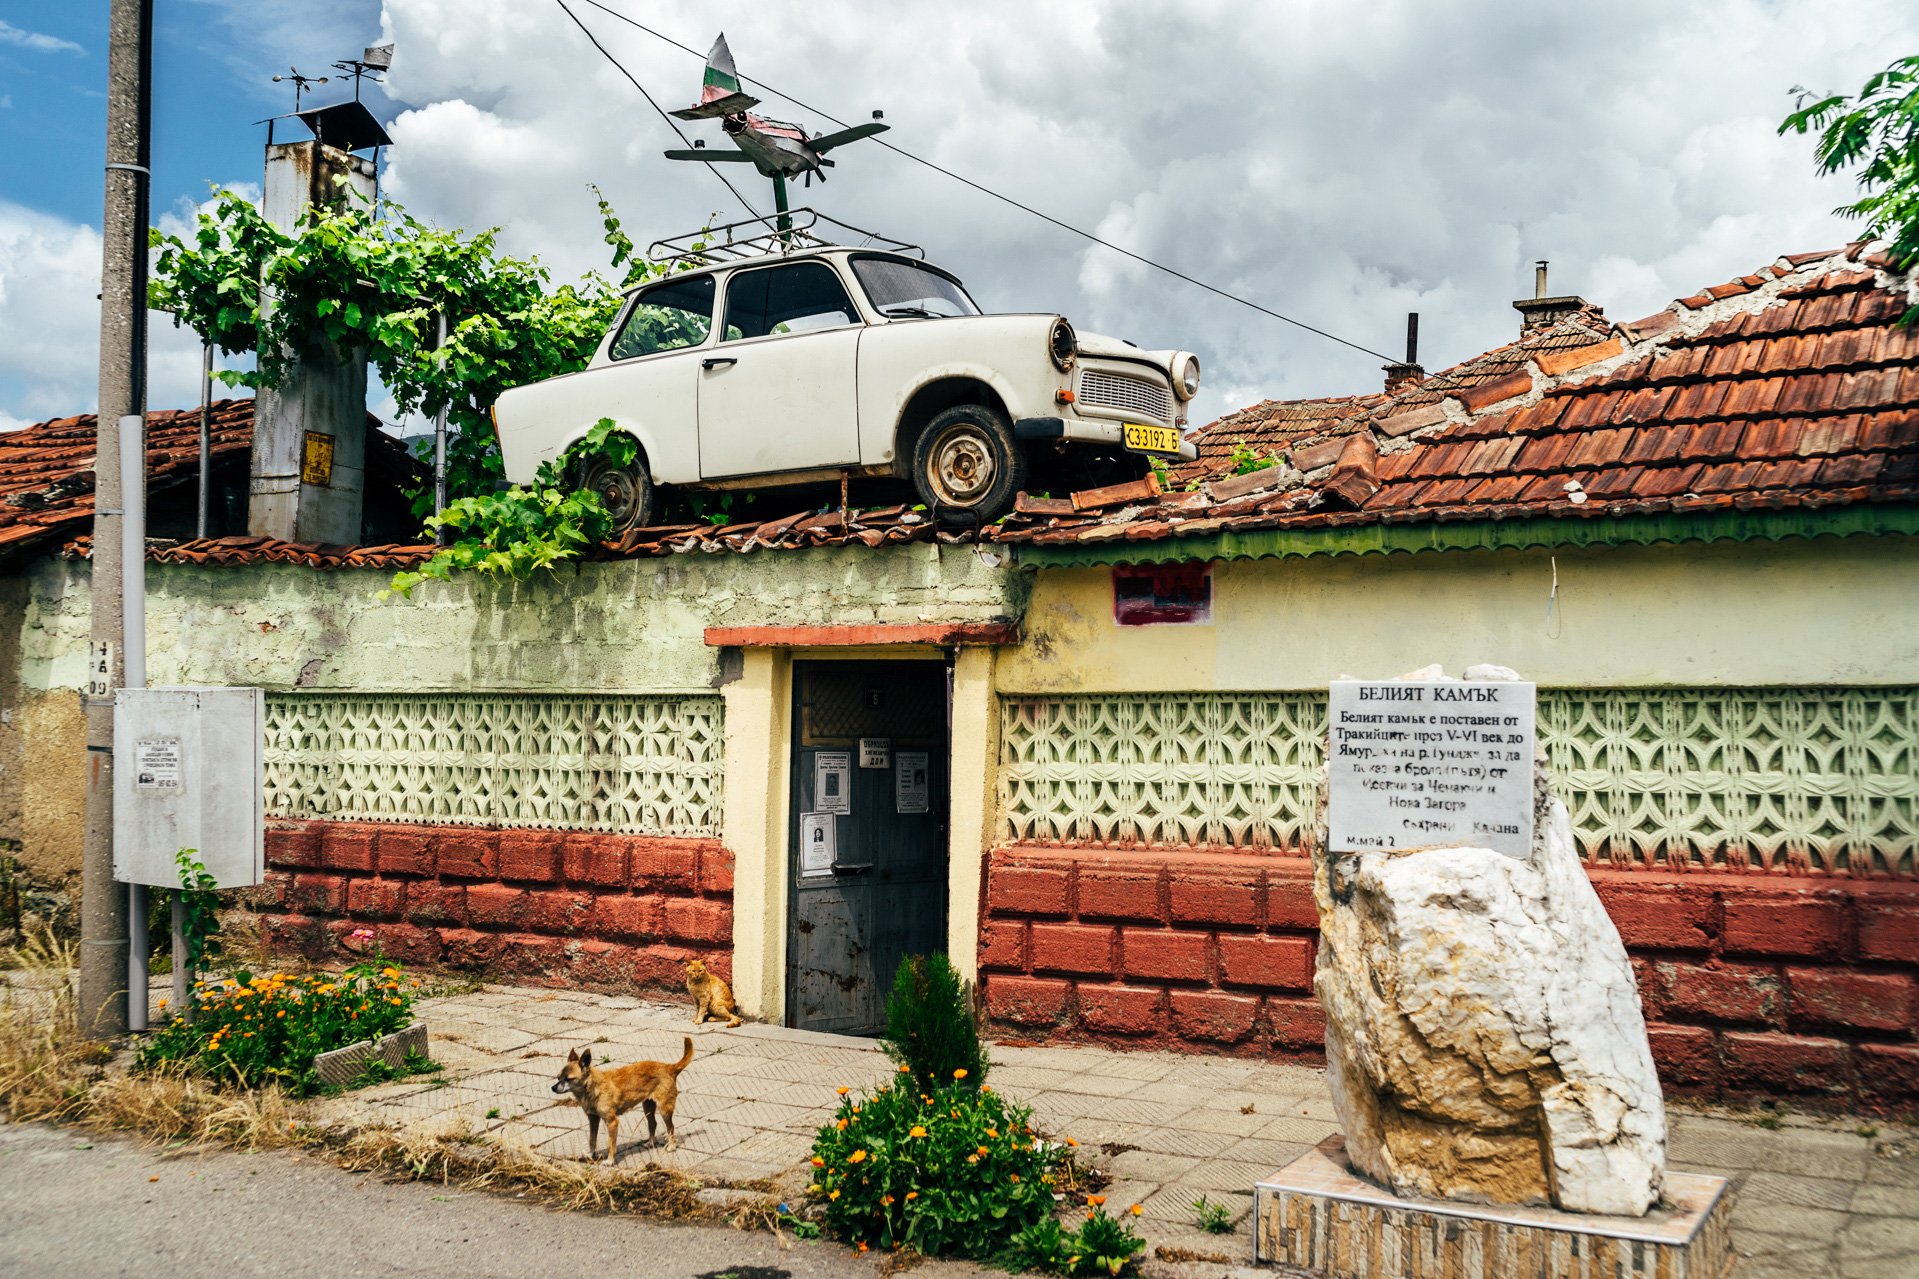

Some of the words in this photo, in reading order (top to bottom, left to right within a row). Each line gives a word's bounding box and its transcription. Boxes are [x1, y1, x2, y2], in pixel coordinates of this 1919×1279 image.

[872, 693, 879, 706] 5
[1359, 687, 1424, 701] БЕЛИЯТ
[1433, 687, 1498, 702] КАМЪК
[1340, 710, 1384, 723] Белият
[1429, 715, 1436, 724] е
[1440, 715, 1500, 726] поставен
[1503, 716, 1519, 726] от
[1336, 727, 1410, 742] Тракийците
[1446, 729, 1477, 742] V-VI
[1481, 732, 1503, 743] век
[1506, 733, 1524, 745] до
[1400, 749, 1415, 758] на
[1487, 750, 1501, 760] за
[869, 757, 884, 766] ДОМ
[1353, 764, 1401, 774] показа
[1489, 767, 1508, 778] от
[1411, 782, 1424, 791] за
[1389, 795, 1420, 808] Нова
[1424, 796, 1466, 811] Загора
[1388, 835, 1395, 847] 2
